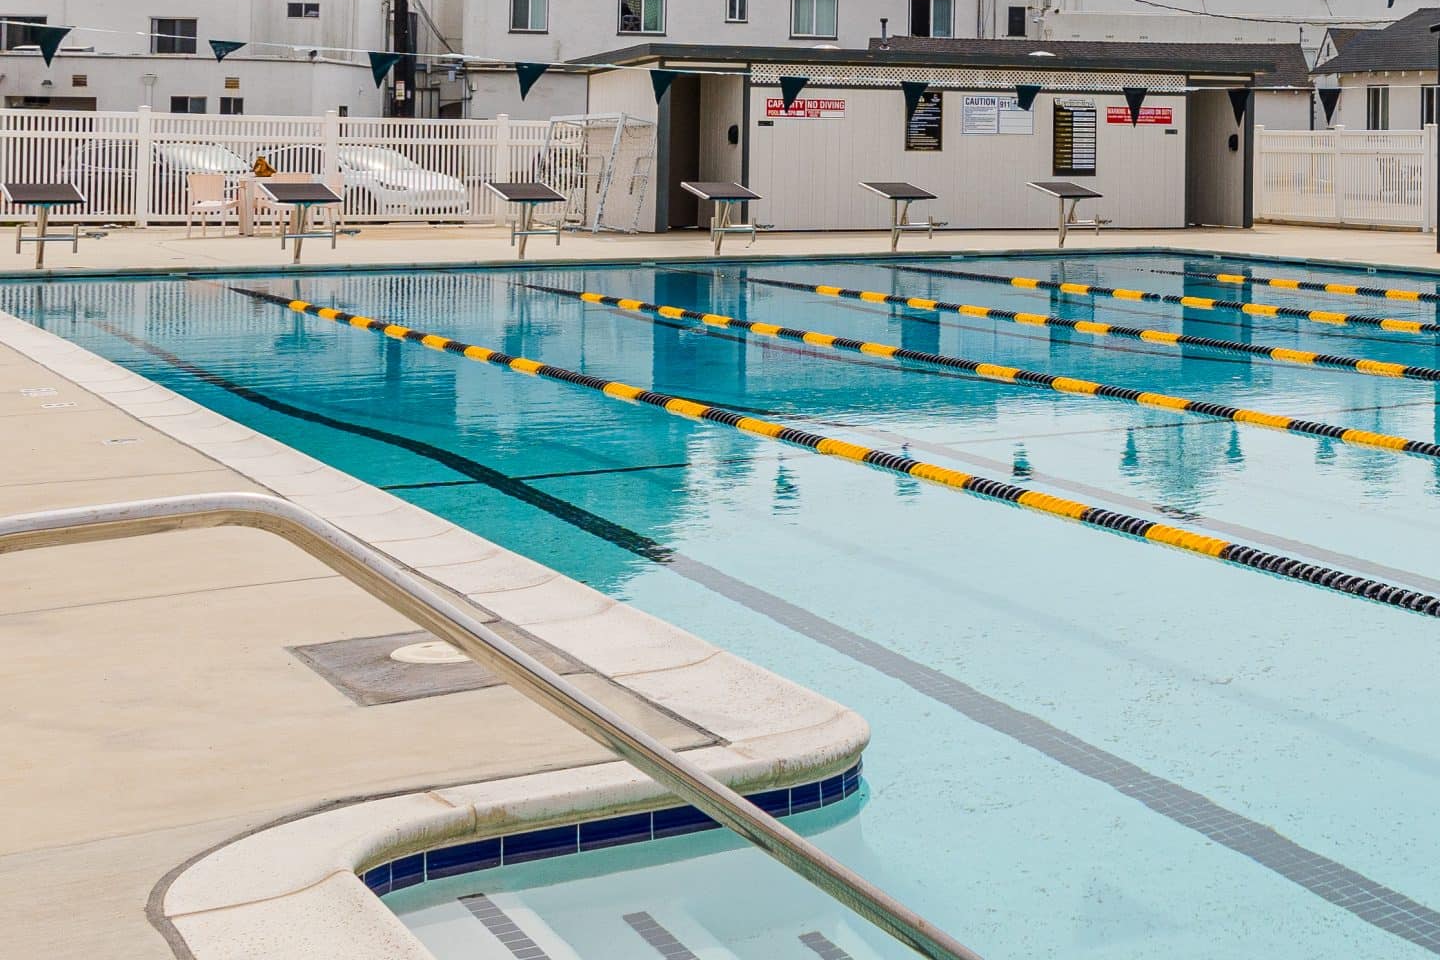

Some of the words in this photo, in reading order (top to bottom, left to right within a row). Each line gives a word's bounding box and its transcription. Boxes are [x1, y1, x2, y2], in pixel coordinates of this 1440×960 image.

[768, 99, 804, 108] CAPITY
[807, 100, 818, 109] NO
[820, 101, 845, 109] DIVING
[965, 97, 996, 106] CAUTION
[999, 100, 1010, 108] 911
